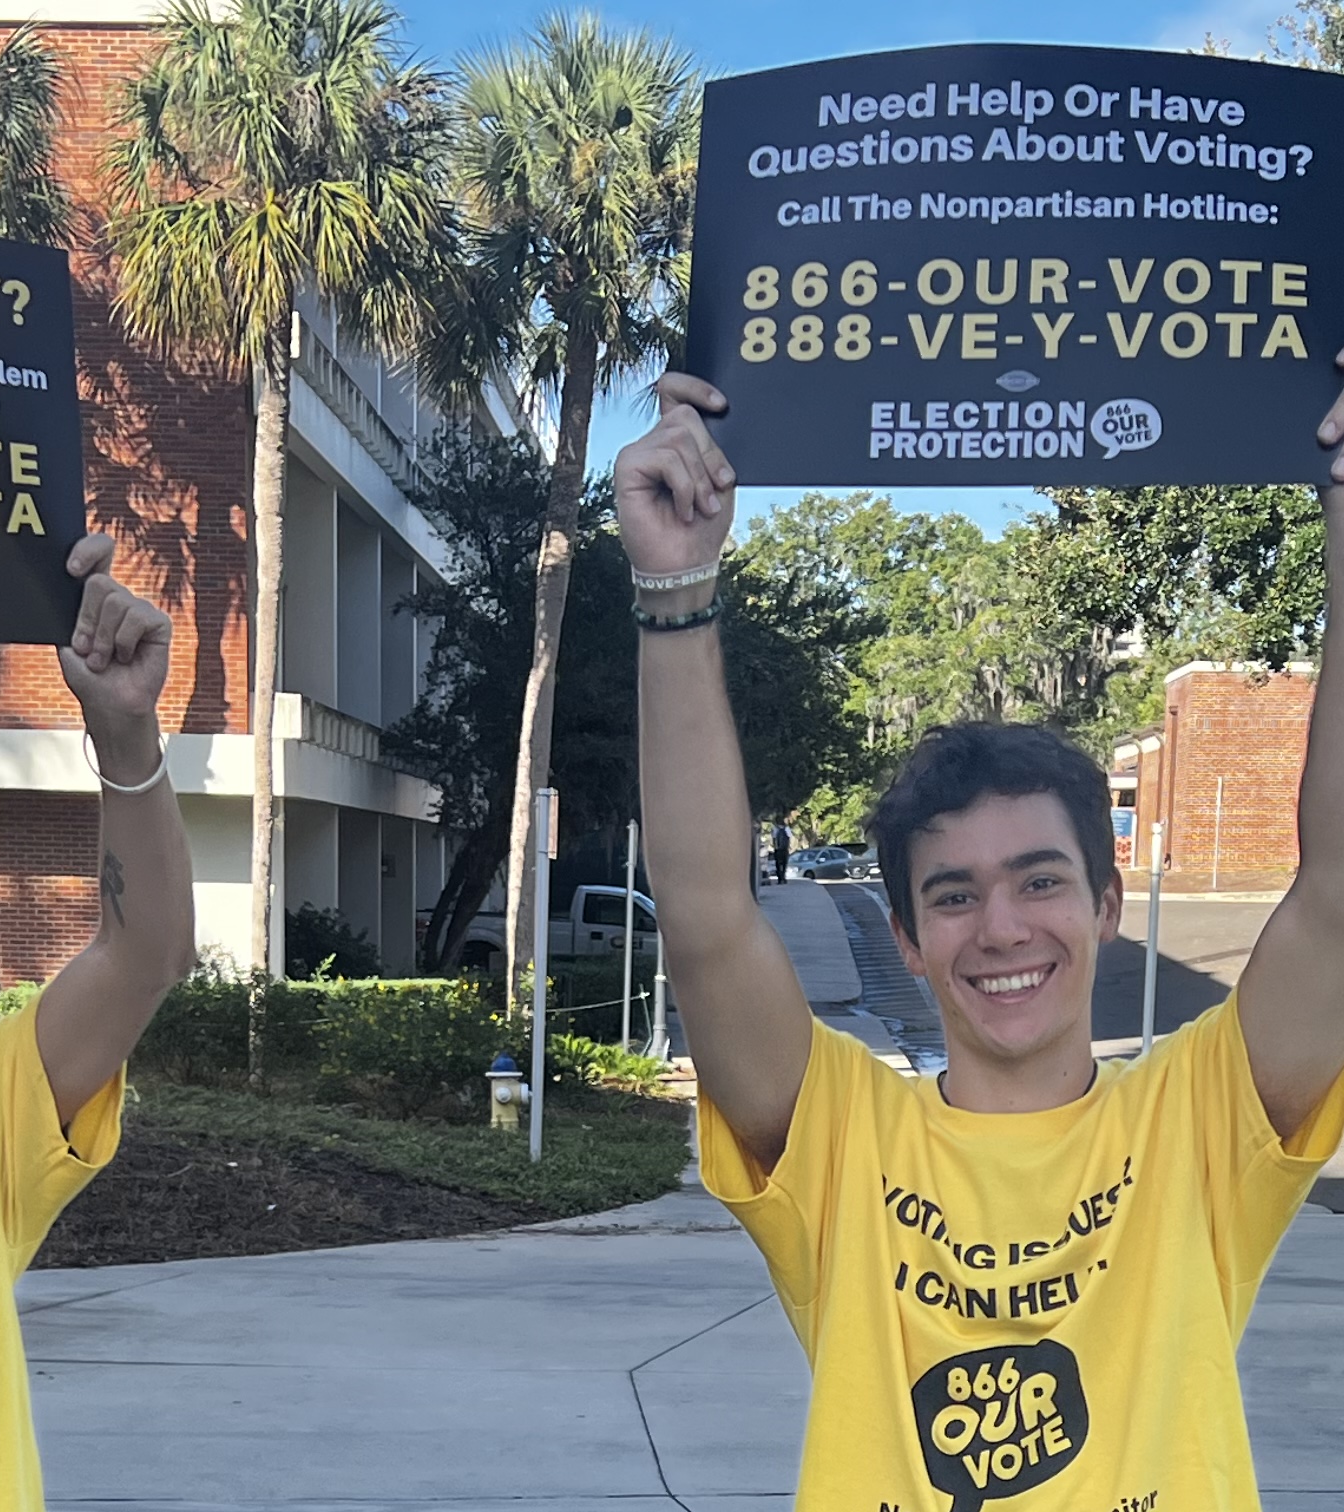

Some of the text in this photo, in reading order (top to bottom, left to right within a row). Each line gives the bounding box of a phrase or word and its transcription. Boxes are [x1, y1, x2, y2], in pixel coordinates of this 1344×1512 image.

[818, 80, 1245, 128] Need Help Or Have
[748, 126, 1312, 181] Questions About Voting?
[777, 192, 1278, 227] Call The Nonpartisan Hotline:
[743, 258, 1309, 311] 866-OUR-VOTE
[740, 312, 1309, 363] 888-VE-Y-VOTA
[872, 401, 1086, 431] ELECTION
[1102, 413, 1148, 435] OUR
[1106, 403, 1131, 417] 866
[869, 429, 1085, 460] PROTECTION
[1114, 429, 1153, 446] VOTE
[894, 1261, 909, 1292] I
[915, 1270, 998, 1319] CAN
[947, 1356, 1021, 1402] 866
[931, 1372, 1058, 1456] OUR
[962, 1415, 1073, 1489] VOTE
